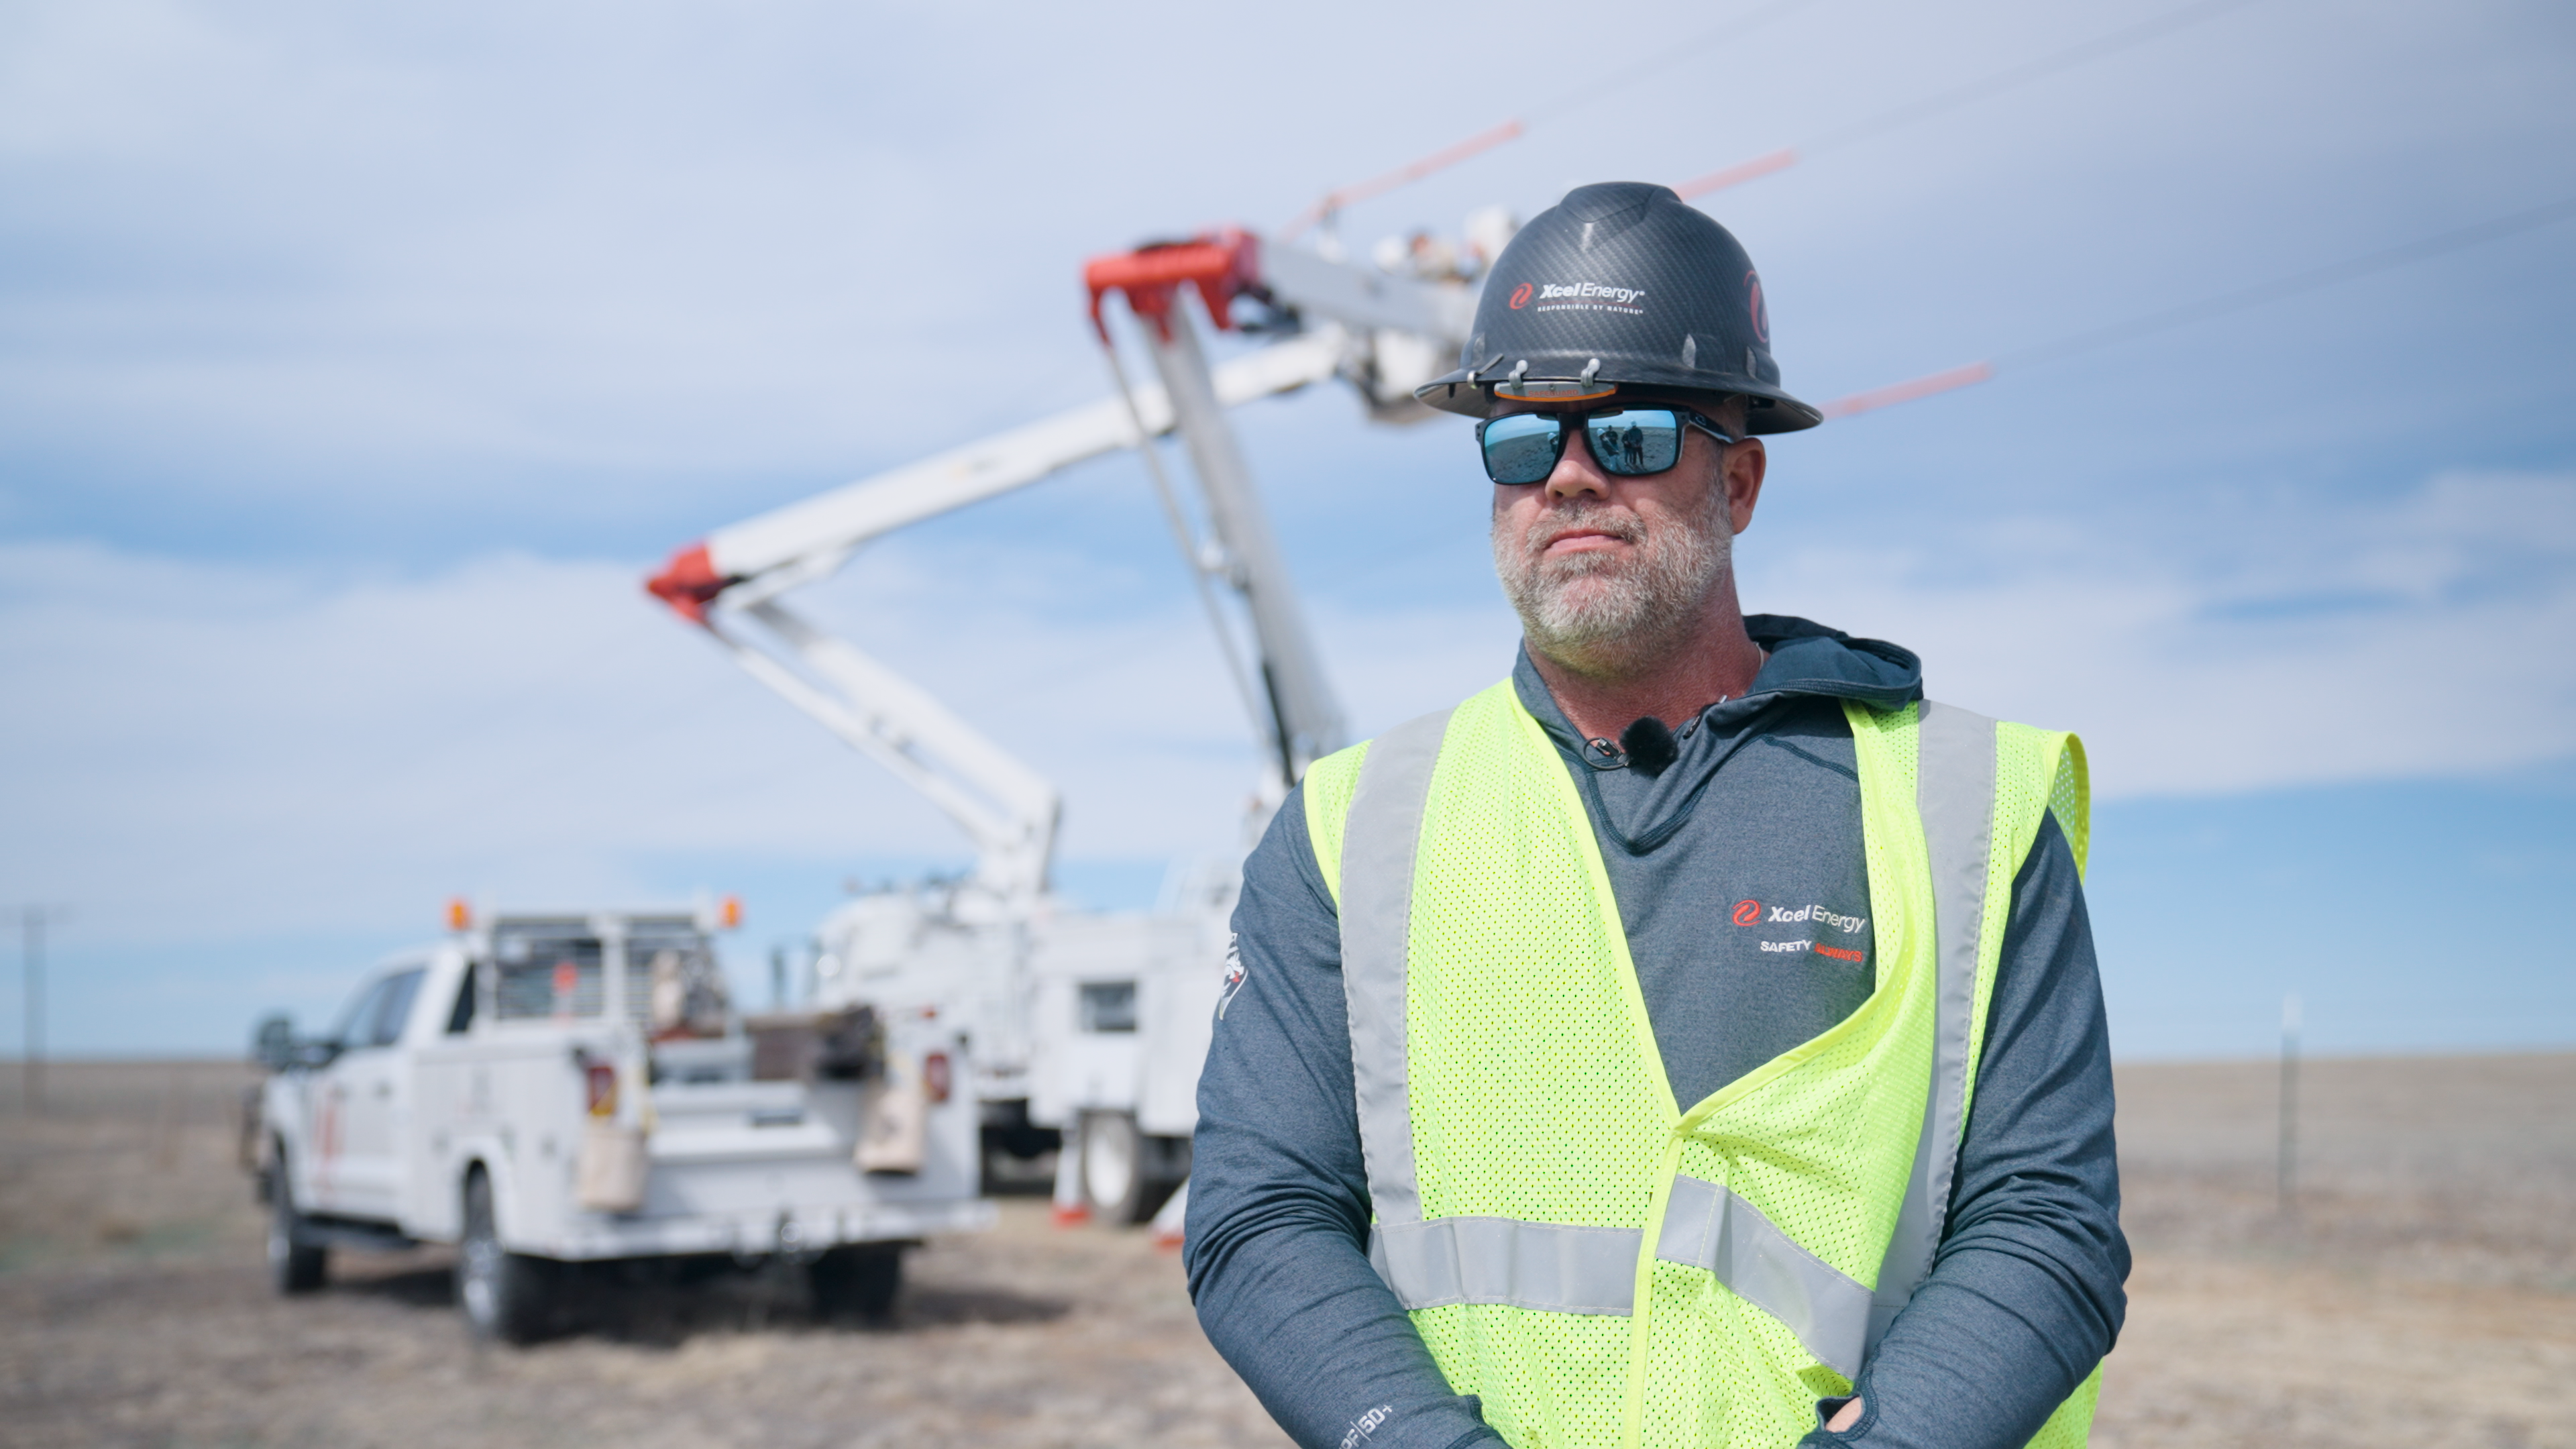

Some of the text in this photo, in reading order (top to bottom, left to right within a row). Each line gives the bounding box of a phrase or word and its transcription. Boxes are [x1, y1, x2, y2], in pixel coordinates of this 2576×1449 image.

[1538, 304, 1589, 312] RESPONSIBLE
[1528, 389, 1579, 397] SAFEGUARD
[1760, 940, 1863, 962] SAFETY ALWAYS
